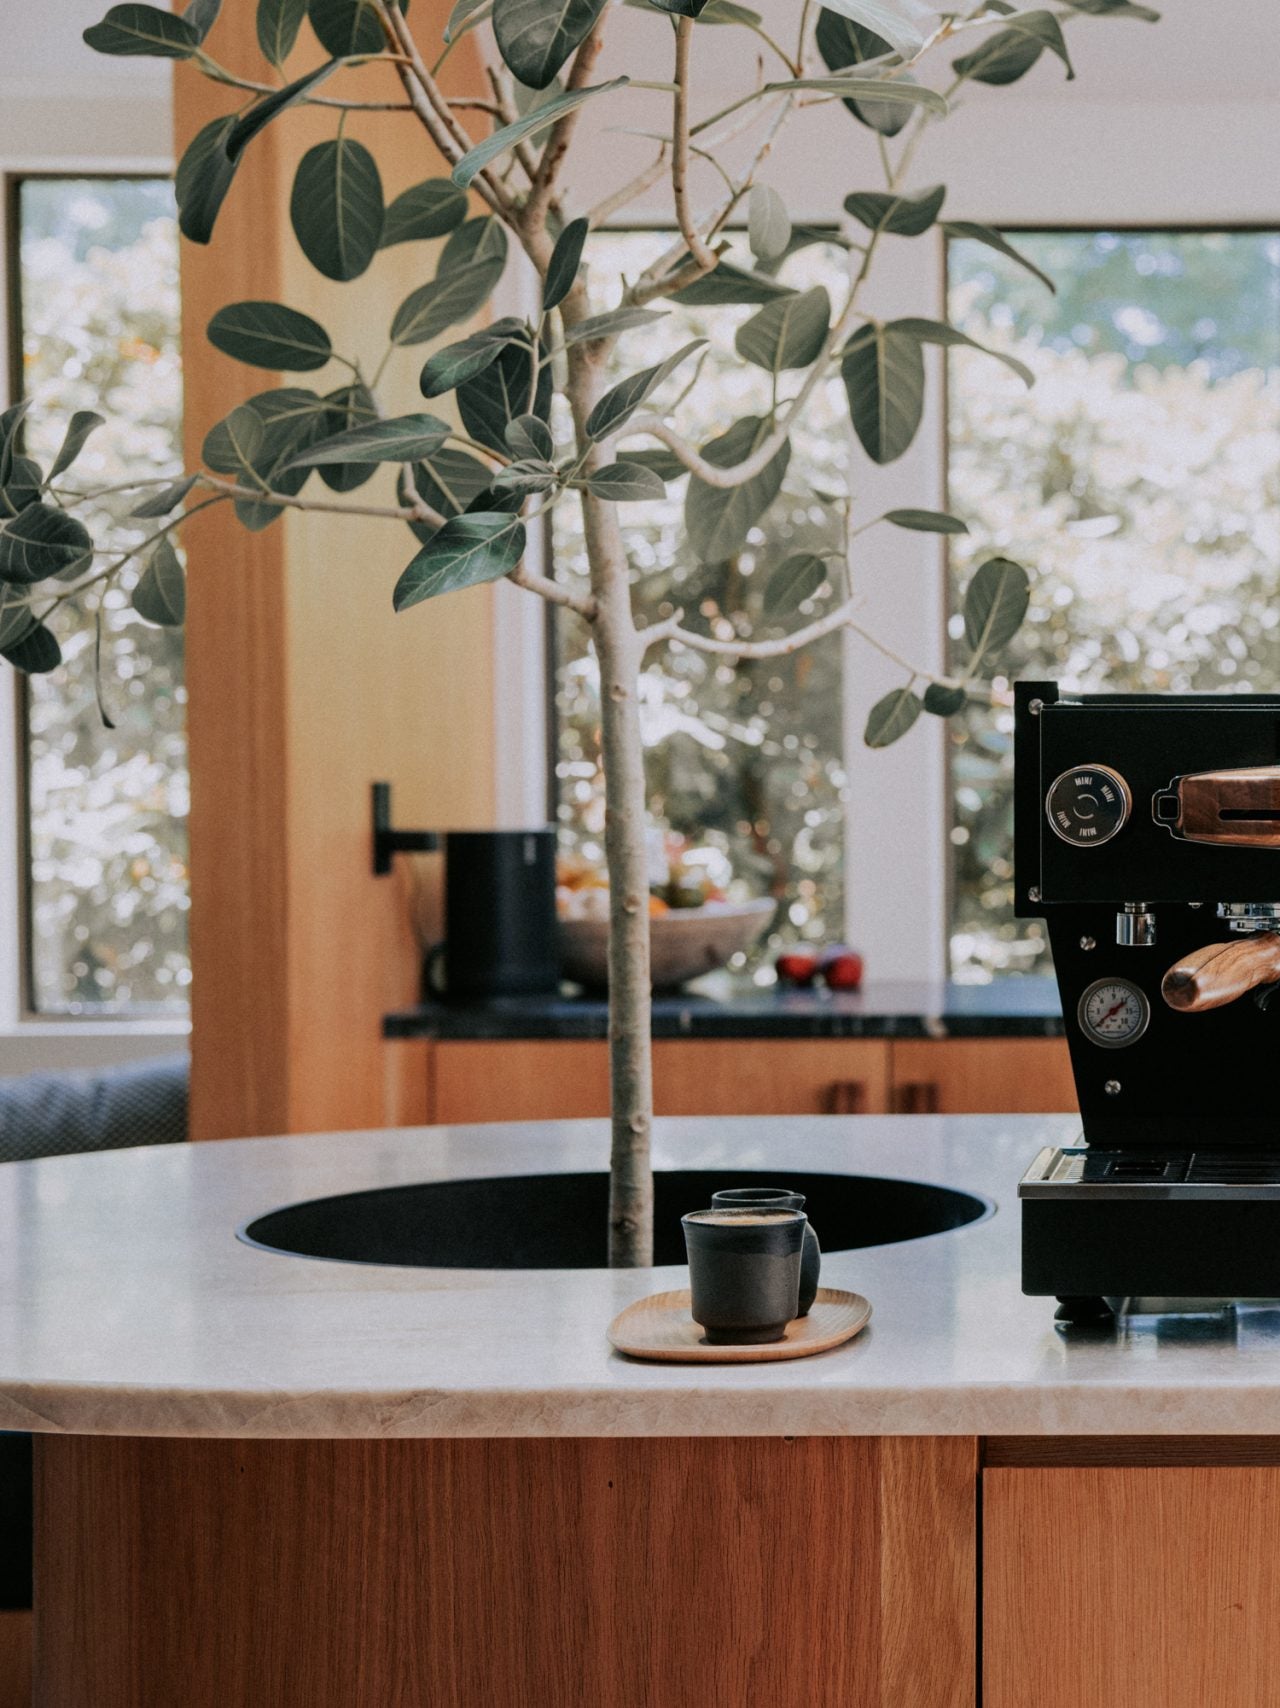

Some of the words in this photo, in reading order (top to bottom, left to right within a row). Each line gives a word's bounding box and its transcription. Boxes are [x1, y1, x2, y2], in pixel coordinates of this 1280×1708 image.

[1075, 776, 1092, 786] MINI
[1100, 785, 1115, 802] MINI
[1057, 811, 1071, 828] MINI
[1079, 827, 1097, 837] MINI
